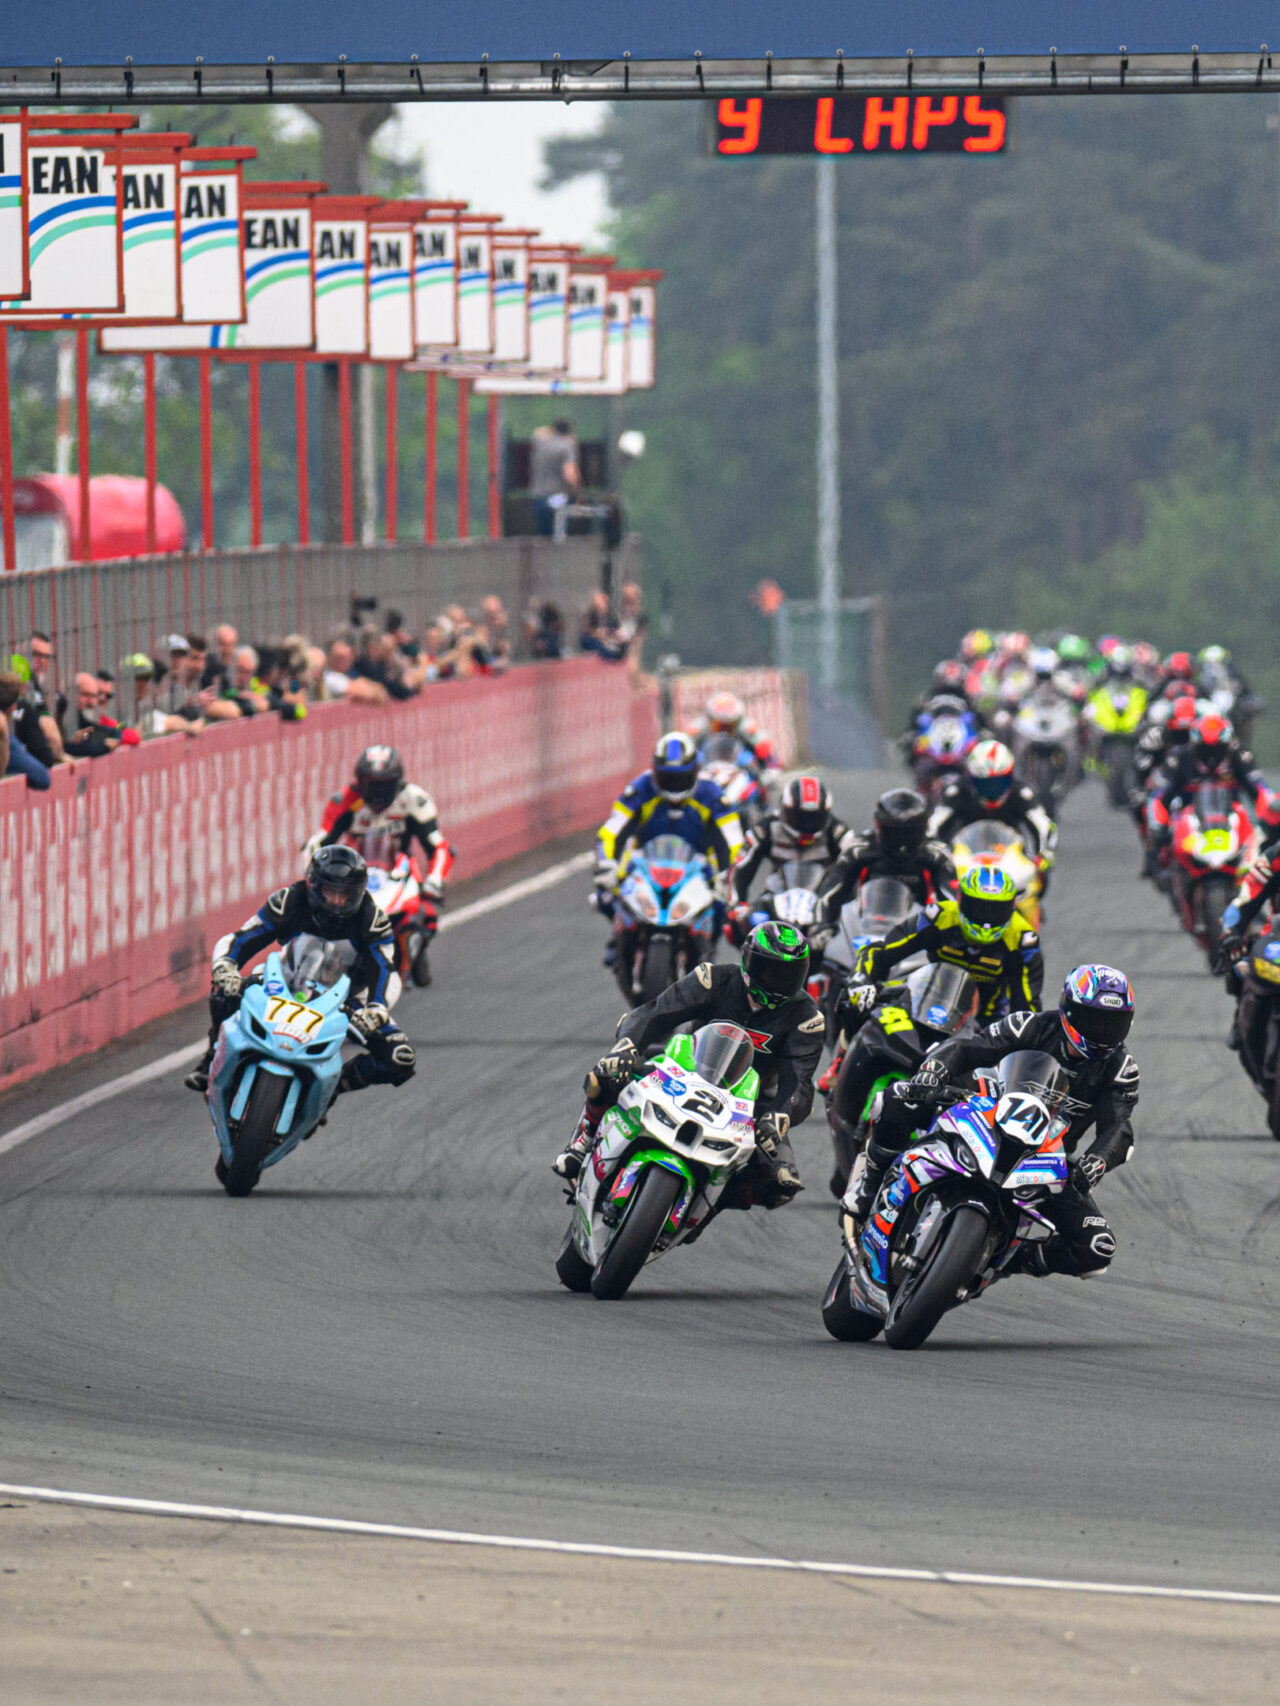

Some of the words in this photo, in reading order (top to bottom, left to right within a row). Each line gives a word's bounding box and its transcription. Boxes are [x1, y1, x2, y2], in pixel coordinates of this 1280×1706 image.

[814, 95, 1006, 154] LAPS
[267, 996, 325, 1034] 777
[1103, 997, 1121, 1006] SHOEI
[681, 1090, 725, 1123] 2
[998, 1096, 1050, 1142] 141
[1082, 1216, 1110, 1229] RS
